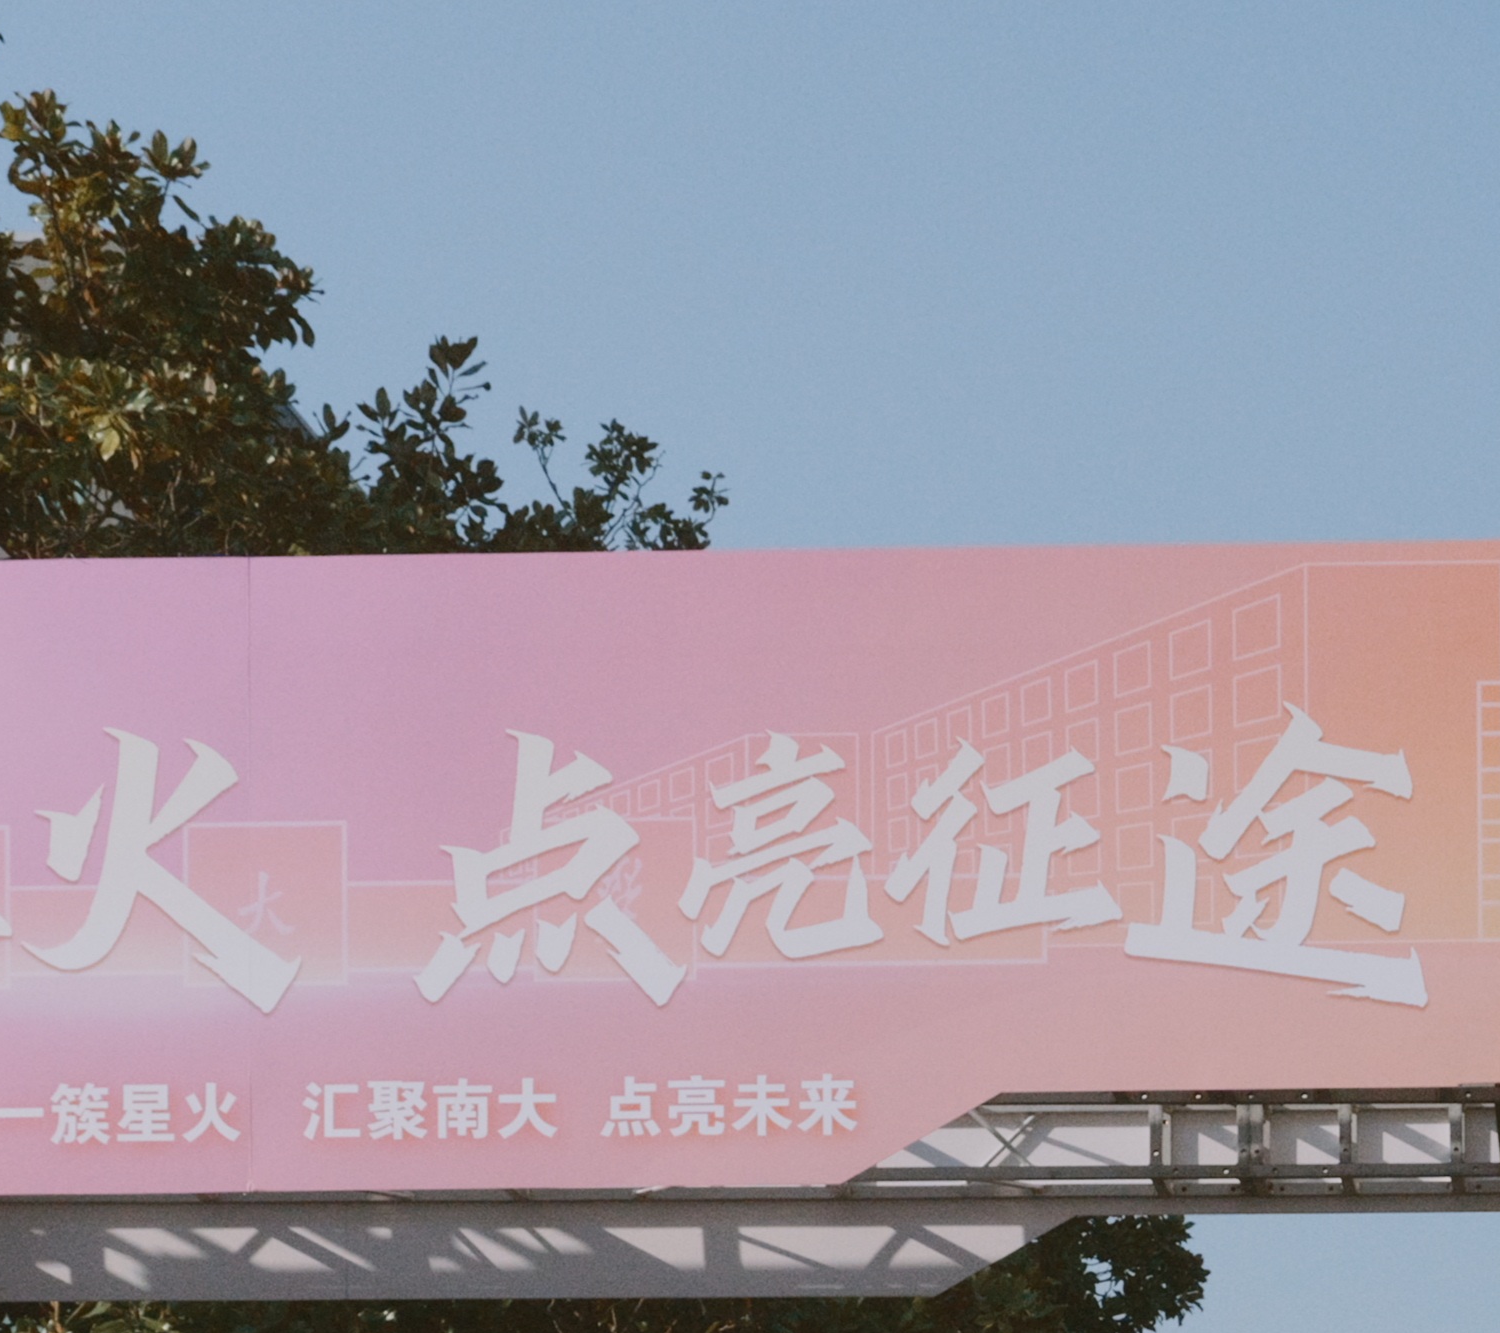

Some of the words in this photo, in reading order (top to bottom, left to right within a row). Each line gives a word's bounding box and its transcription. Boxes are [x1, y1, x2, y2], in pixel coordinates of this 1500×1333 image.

[413, 703, 1428, 1006] 点亮征途
[302, 1076, 558, 1142] 汇聚南大
[600, 1072, 858, 1138] 点亮未来
